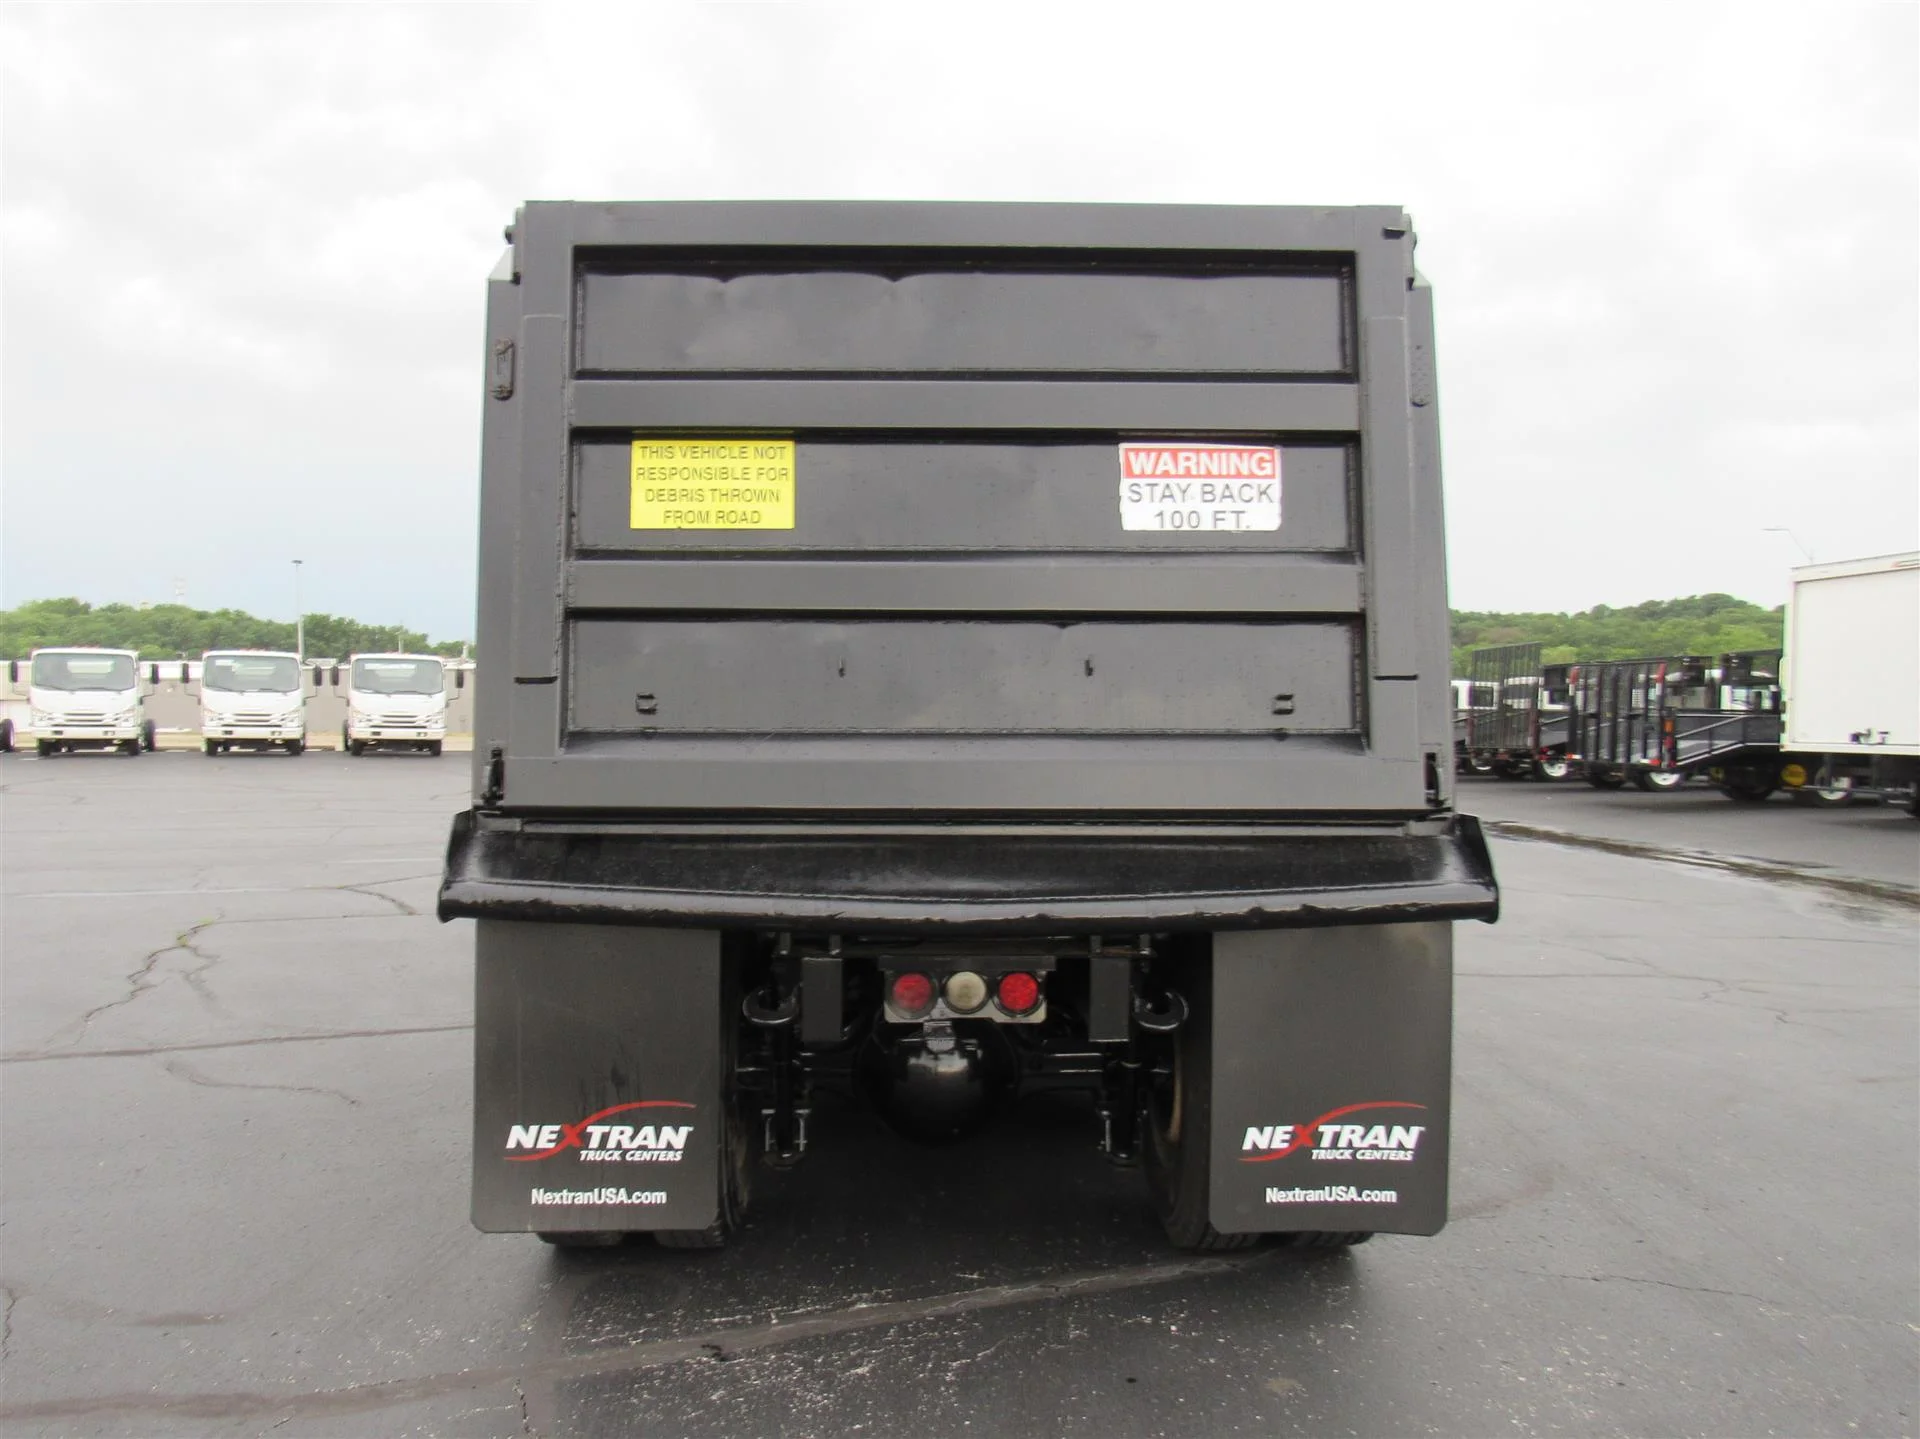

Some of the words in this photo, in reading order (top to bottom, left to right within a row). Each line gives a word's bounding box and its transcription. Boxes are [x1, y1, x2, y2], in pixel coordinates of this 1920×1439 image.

[640, 446, 674, 459] THIS
[680, 446, 748, 459] VEHICLE
[753, 446, 787, 459] NOT
[1128, 451, 1273, 476] WARNING
[636, 467, 751, 481] RESPONSIBLE
[756, 467, 789, 481] FOR
[645, 488, 705, 502] DEBRIS
[709, 488, 780, 502] THROWN
[1128, 483, 1191, 503] STAY
[1201, 483, 1274, 503] BACK
[663, 510, 710, 524] FROM
[715, 510, 761, 524] ROAD
[1155, 510, 1200, 529] 100
[1213, 510, 1251, 529] FT.
[505, 1124, 691, 1149] NEXTRAN
[1242, 1124, 1422, 1150] NEXTRAN
[579, 1150, 622, 1161] TRUCK
[625, 1150, 683, 1161] CENTERS
[1311, 1149, 1353, 1160] TRUCK
[1356, 1149, 1414, 1161] CENTERS
[531, 1187, 667, 1205] NextranUSA.com
[1265, 1186, 1397, 1204] NextranUSA.com
